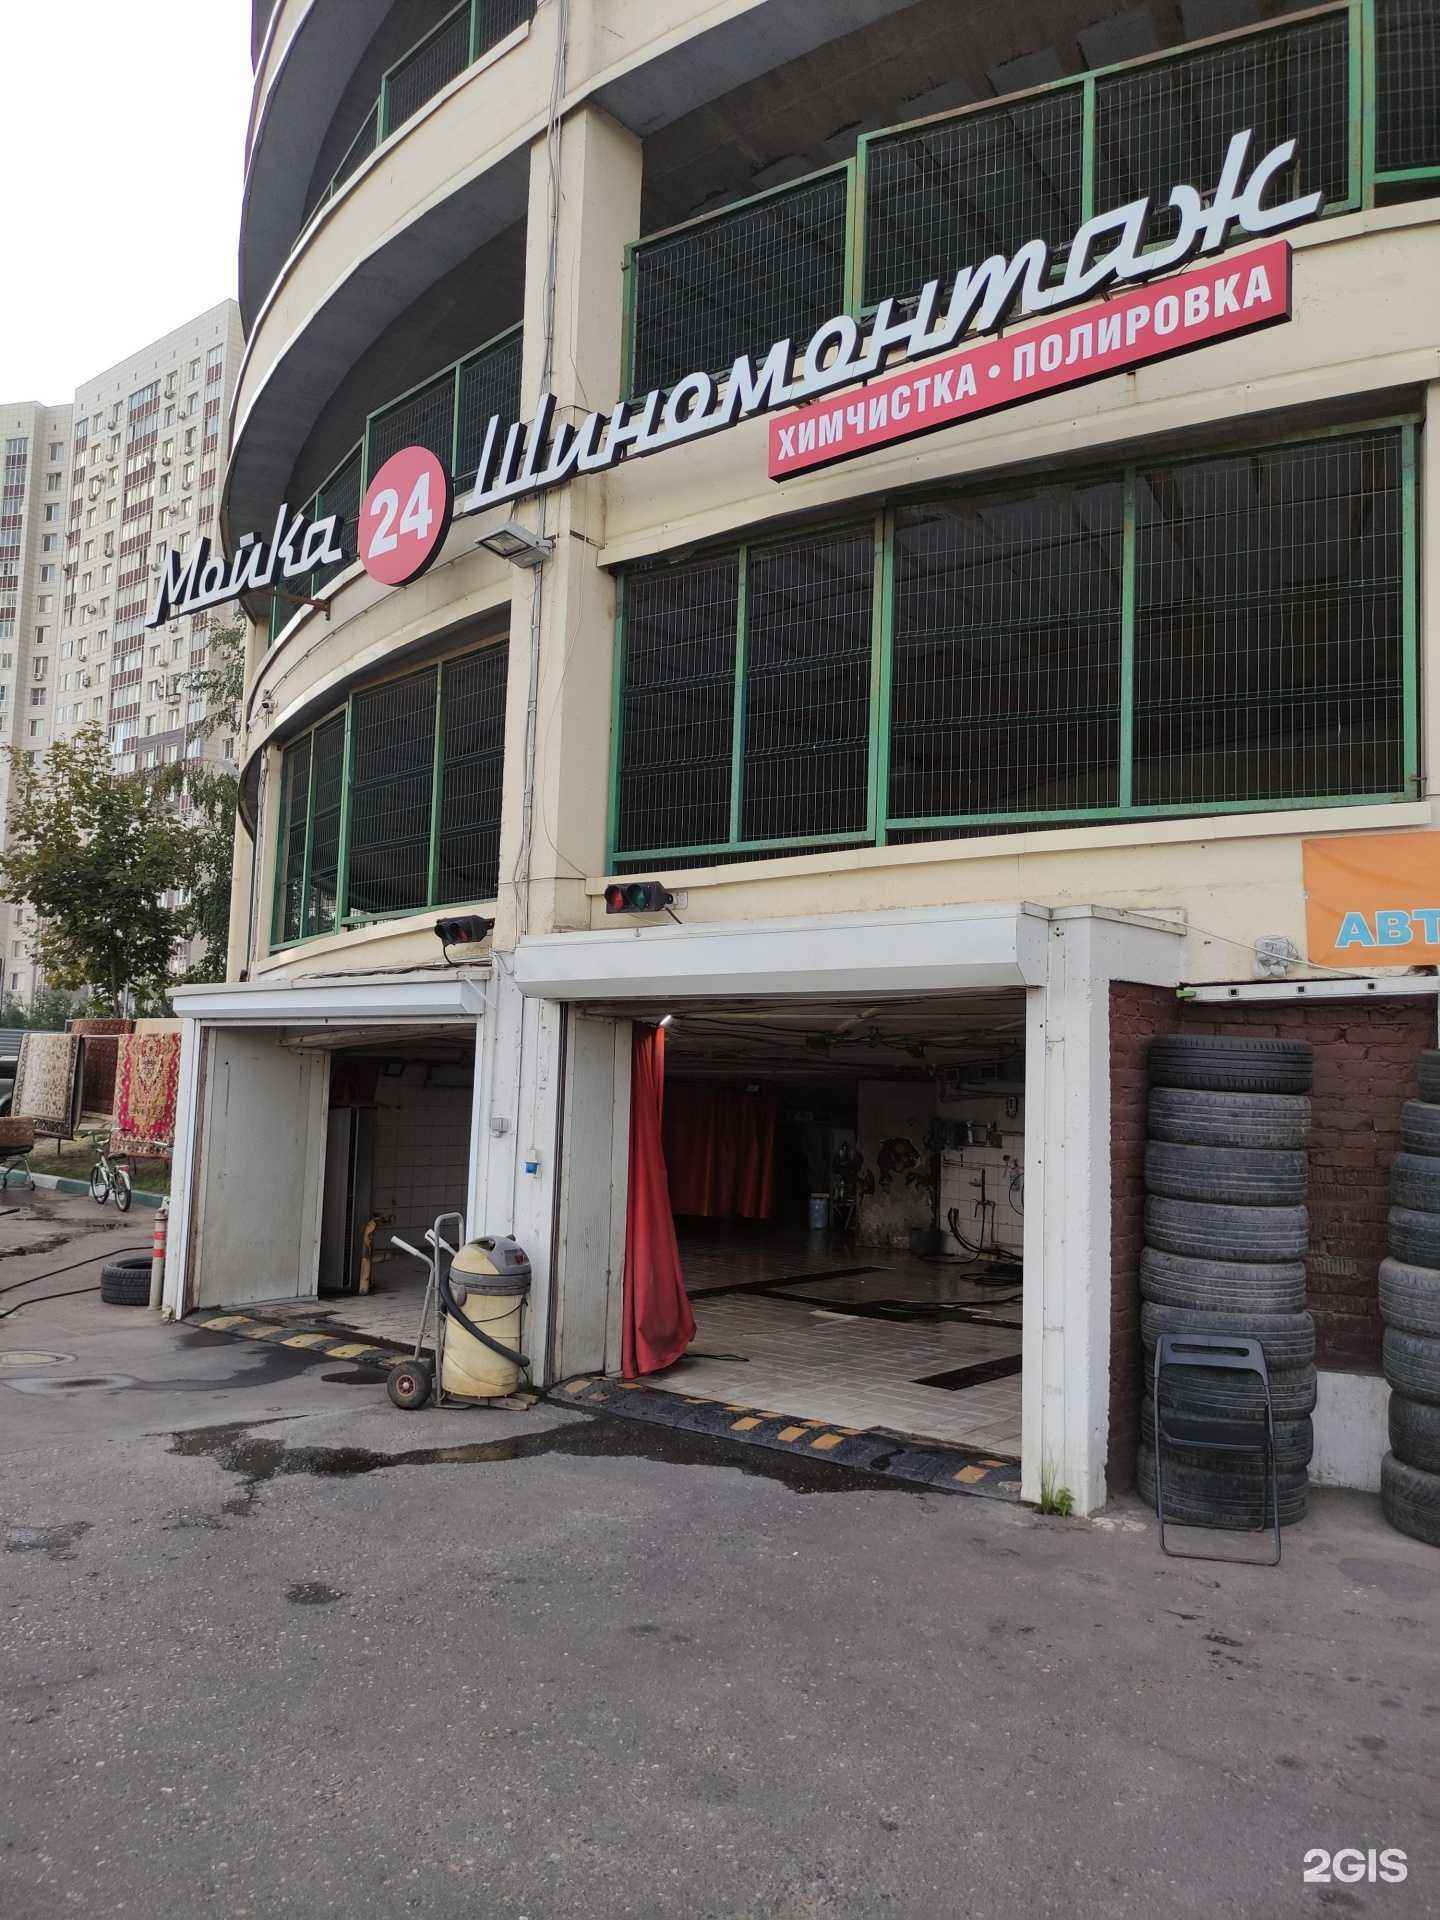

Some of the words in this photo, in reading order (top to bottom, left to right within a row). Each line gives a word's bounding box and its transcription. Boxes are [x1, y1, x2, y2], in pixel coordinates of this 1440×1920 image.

[145, 502, 343, 628] Мойка
[367, 471, 433, 559] 24
[463, 128, 1324, 513] Шиномонтаж
[777, 371, 978, 461] ХИМЧИСТКА
[1012, 264, 1274, 380] ПОЛИРОВКА
